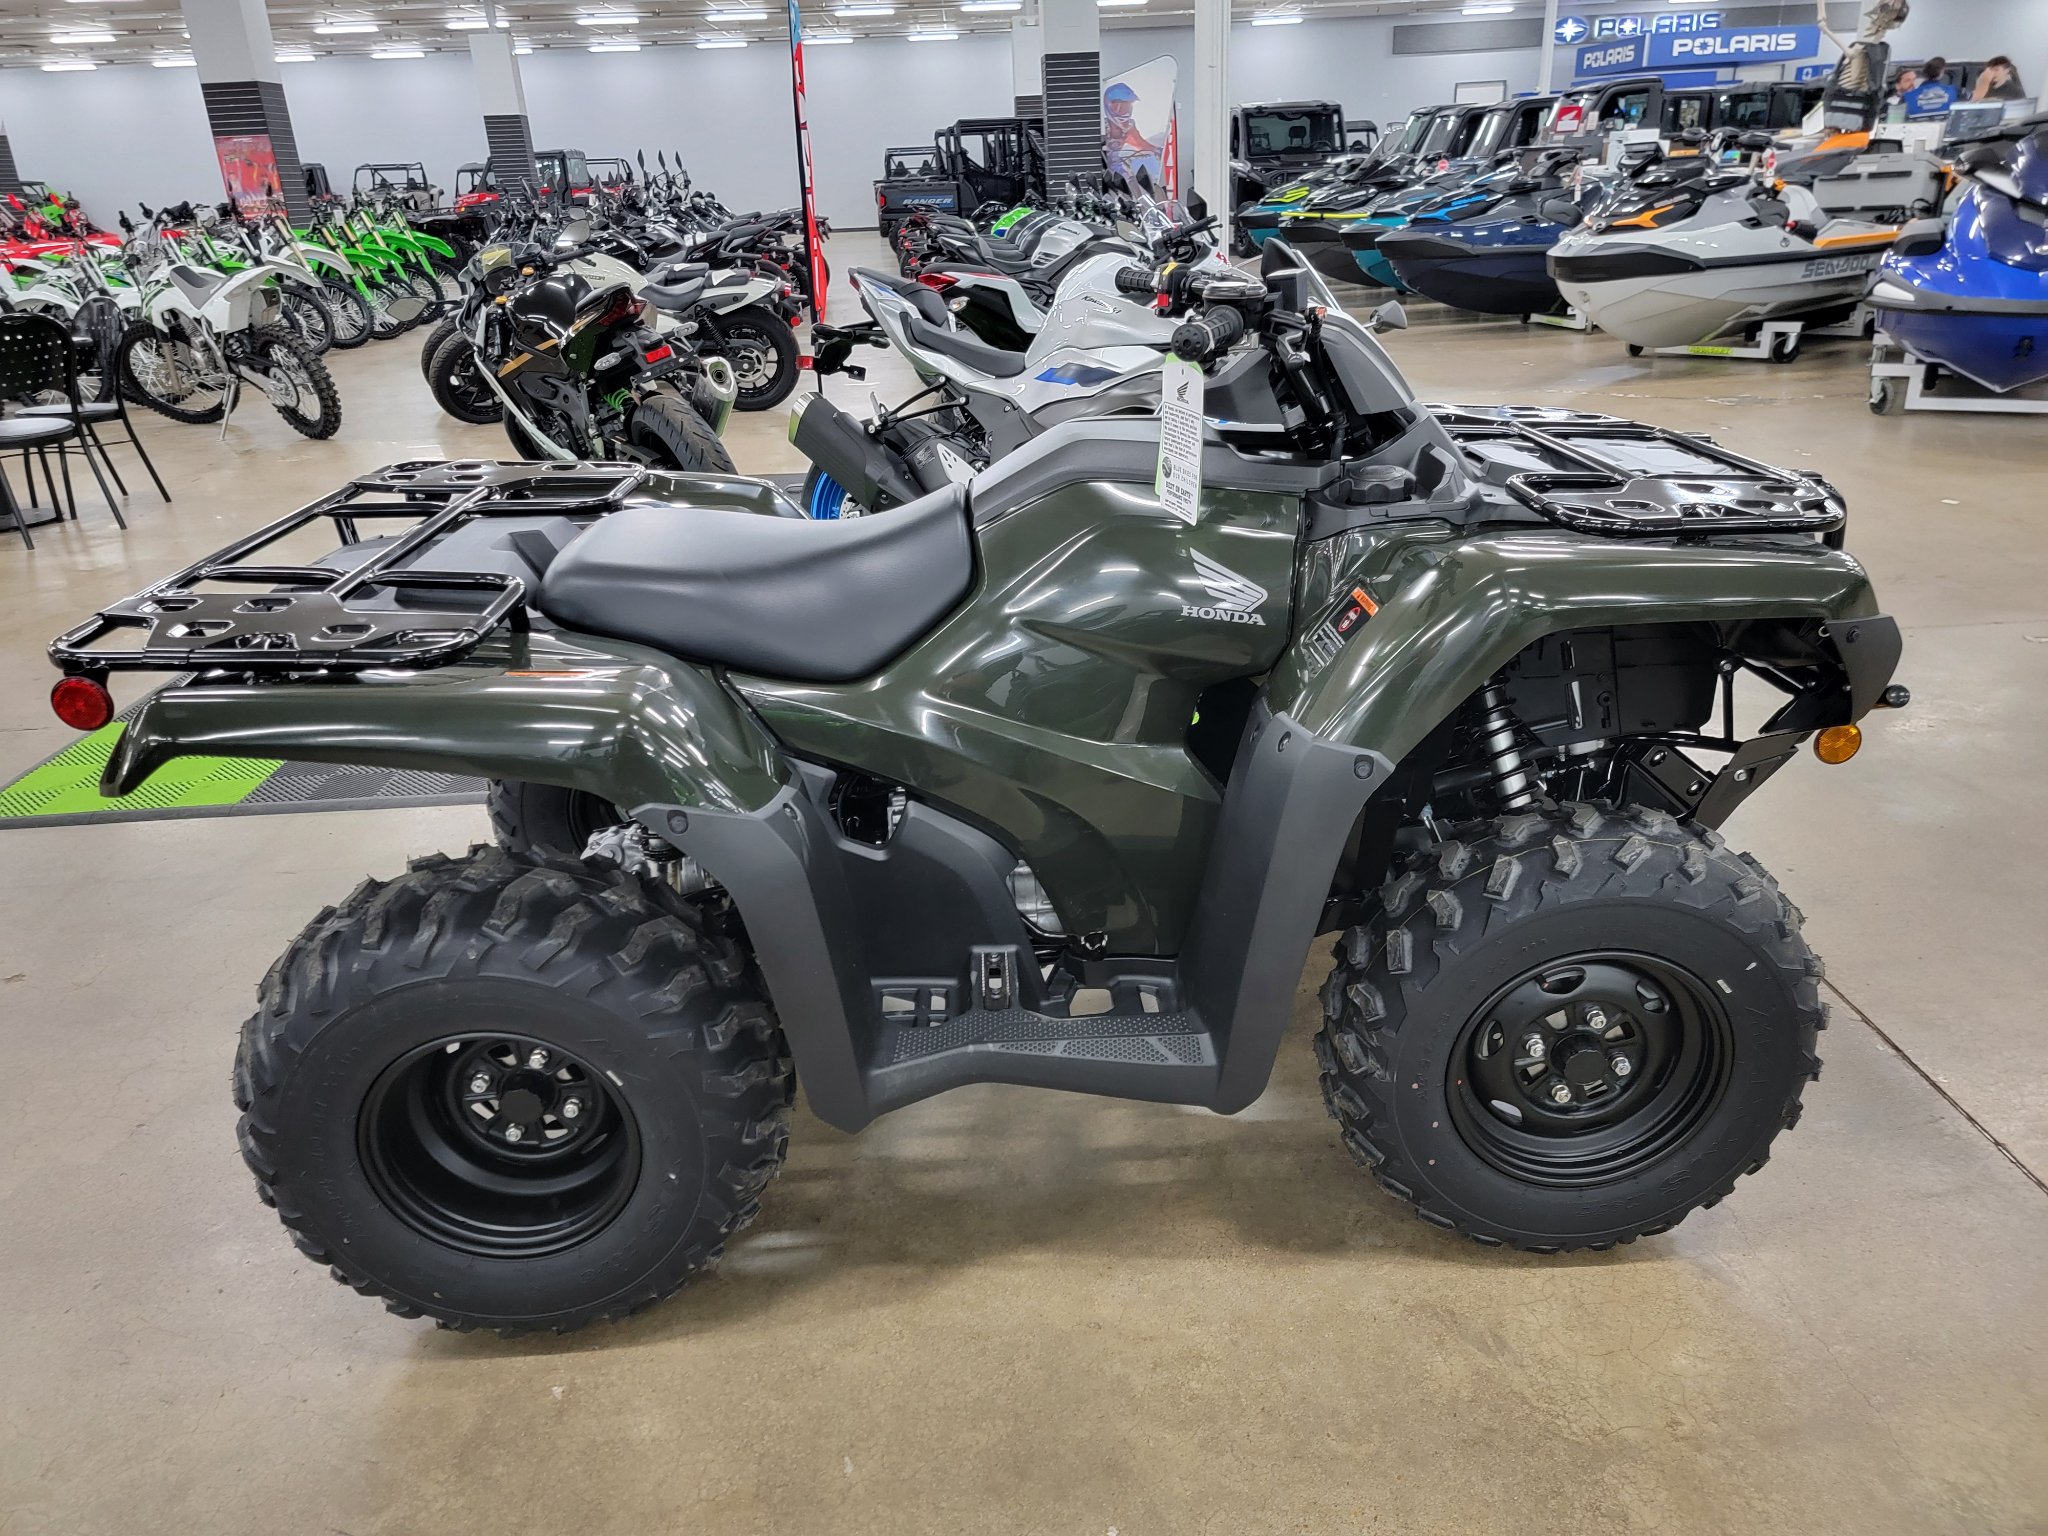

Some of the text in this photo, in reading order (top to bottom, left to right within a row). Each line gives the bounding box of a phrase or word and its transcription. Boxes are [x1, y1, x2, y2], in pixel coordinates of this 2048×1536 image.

[1594, 13, 1725, 39] POLARIS
[1672, 33, 1796, 57] POLARIS
[1583, 45, 1635, 70] POLARIS
[1181, 605, 1266, 626] HONDA
